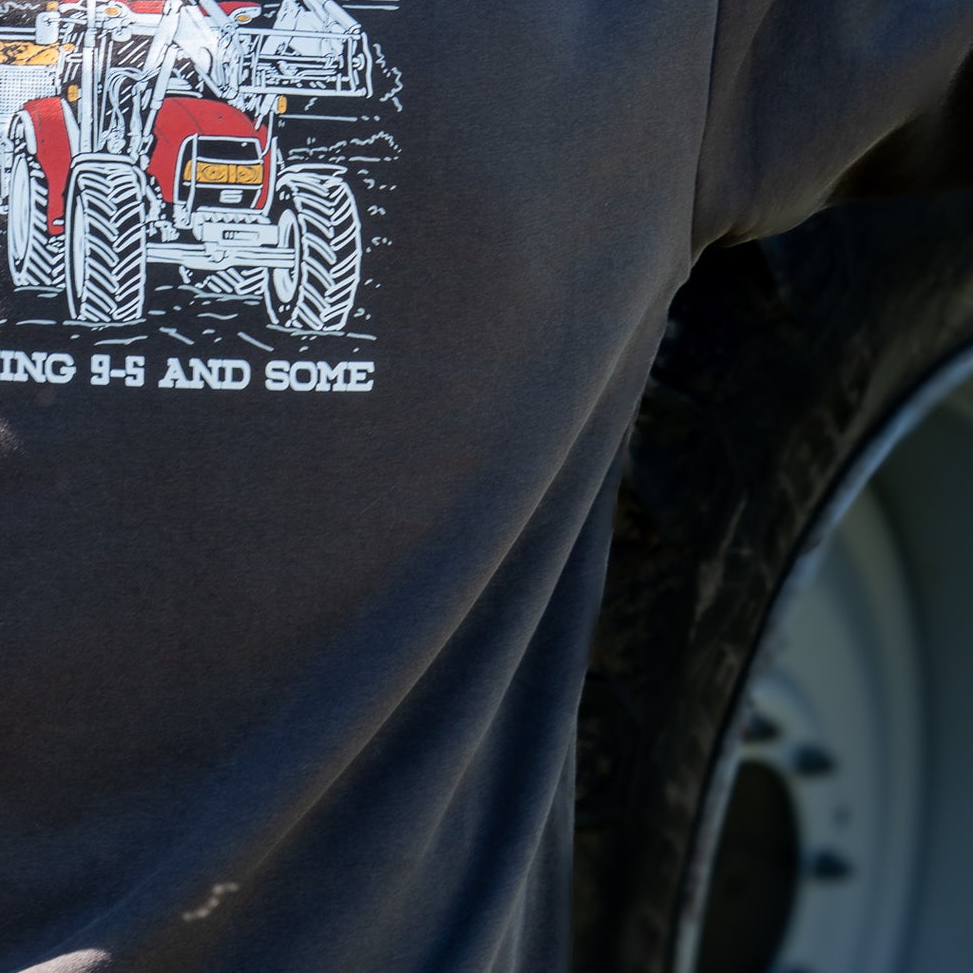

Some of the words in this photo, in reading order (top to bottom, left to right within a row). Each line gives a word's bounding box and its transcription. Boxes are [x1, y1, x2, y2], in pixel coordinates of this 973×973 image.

[90, 354, 145, 387] 9-5
[158, 359, 251, 390] AND
[265, 361, 375, 393] SOME
